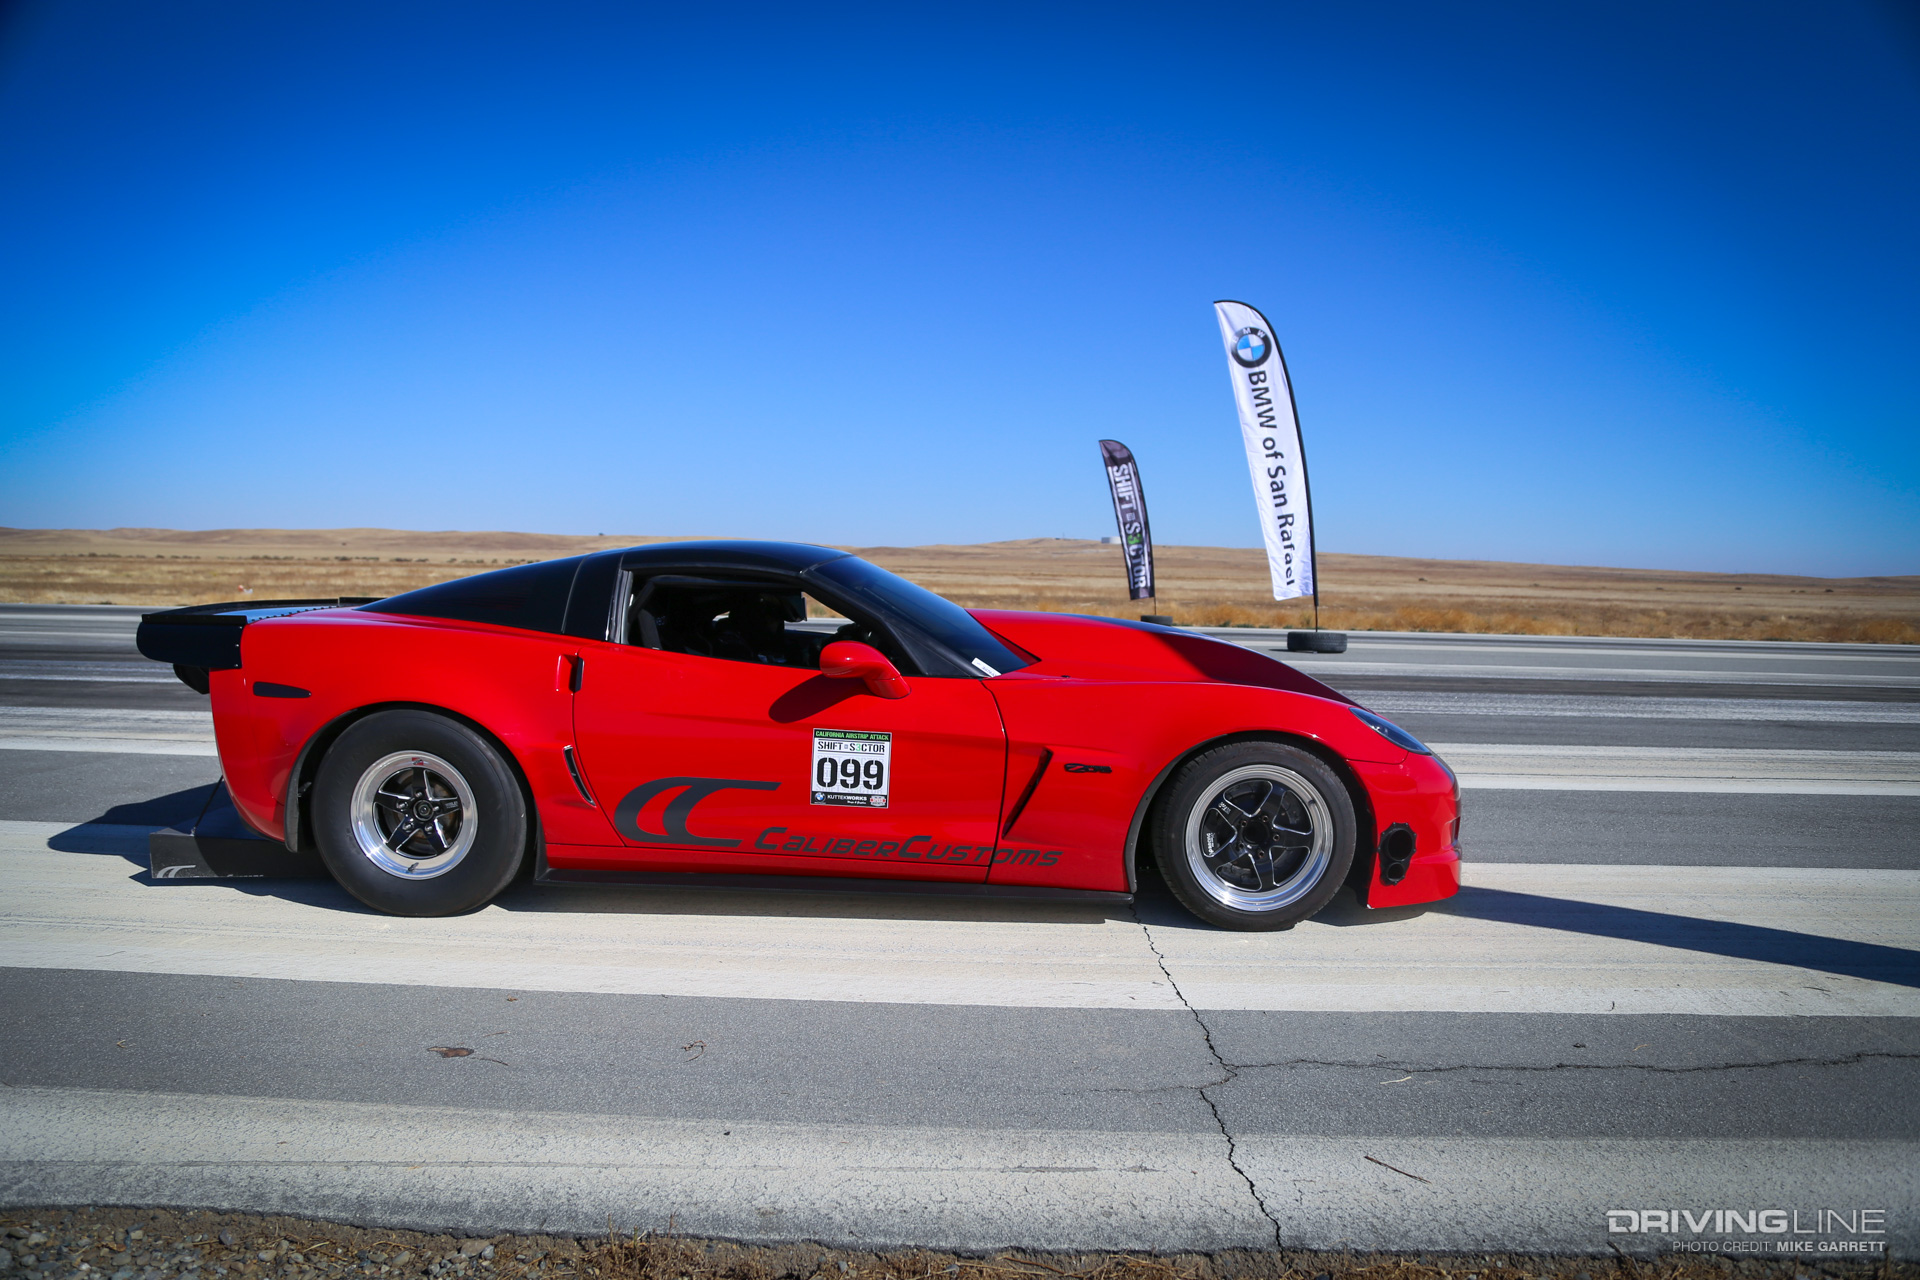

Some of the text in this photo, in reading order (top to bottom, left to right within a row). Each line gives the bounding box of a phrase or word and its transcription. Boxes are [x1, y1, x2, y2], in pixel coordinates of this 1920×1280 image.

[1113, 463, 1137, 510] SHIFT
[1248, 370, 1295, 586] BMW of San Rafael
[815, 730, 845, 739] CALIFORNIA
[845, 732, 869, 740] AIRSTRIP
[817, 741, 885, 753] SHIFT S3CTOR
[816, 757, 884, 790] 099
